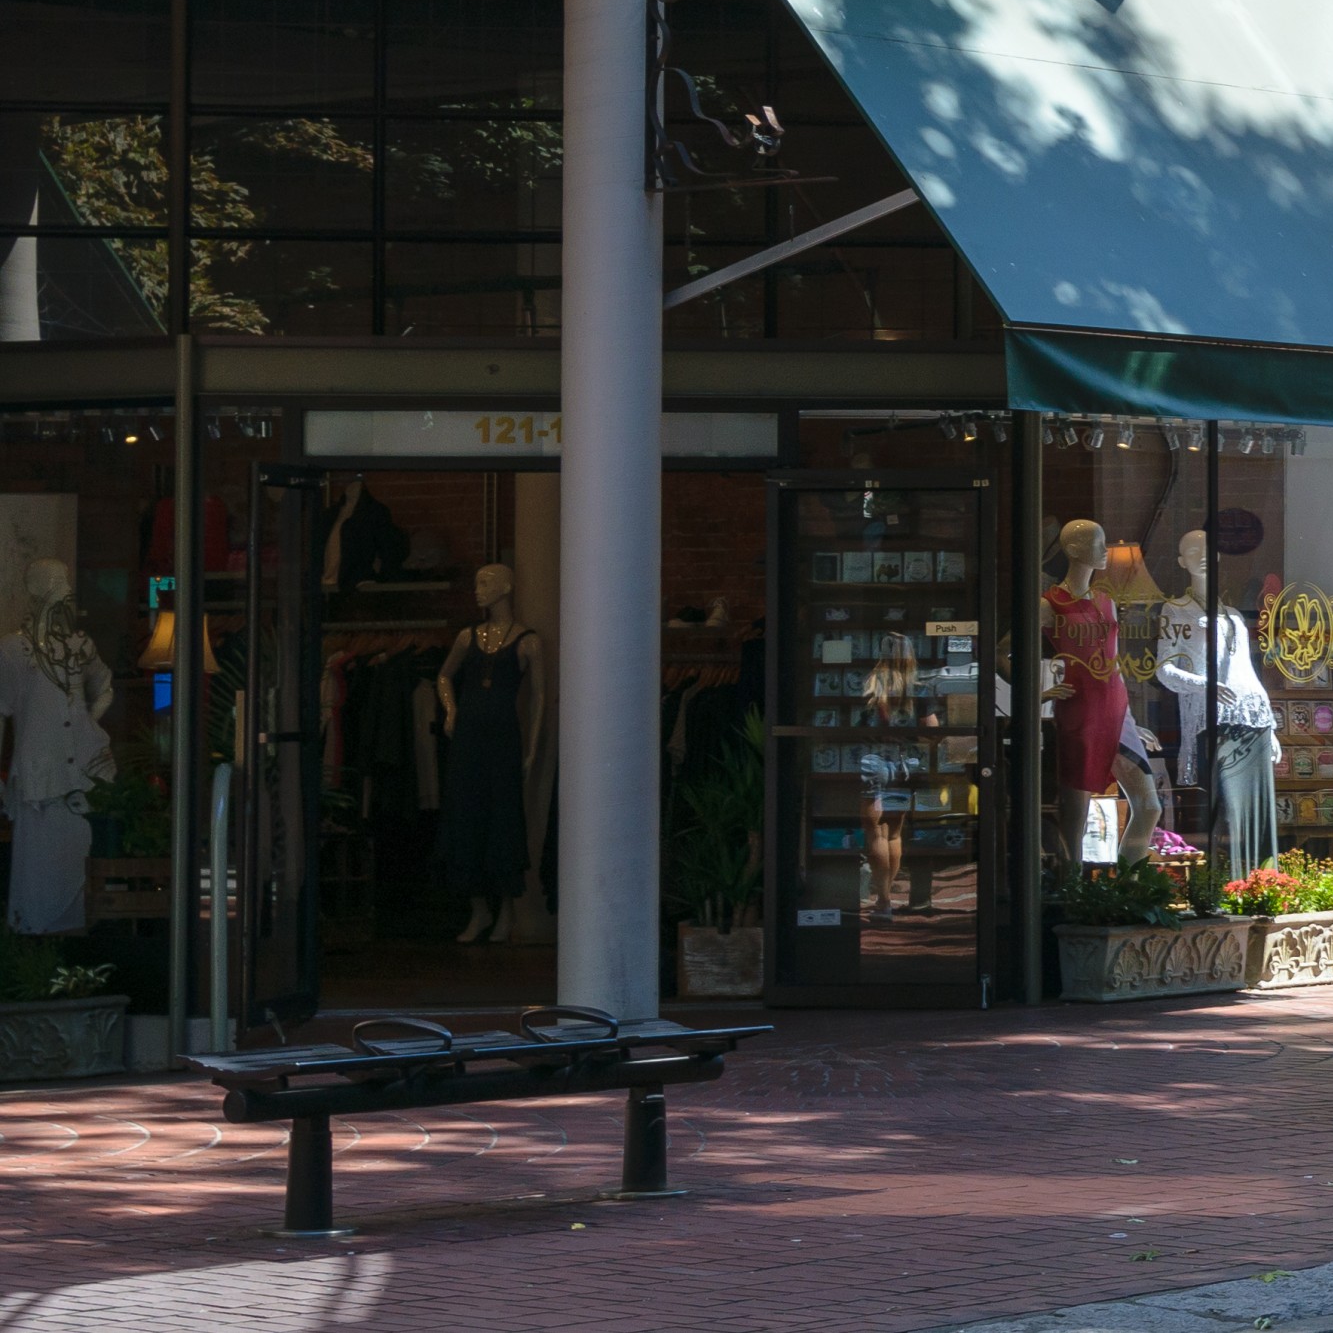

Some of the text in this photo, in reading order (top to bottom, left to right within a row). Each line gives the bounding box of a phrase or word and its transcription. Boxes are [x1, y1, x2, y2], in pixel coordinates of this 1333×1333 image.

[935, 624, 957, 633] Push
[1052, 614, 1192, 647] Poppy and Rye
